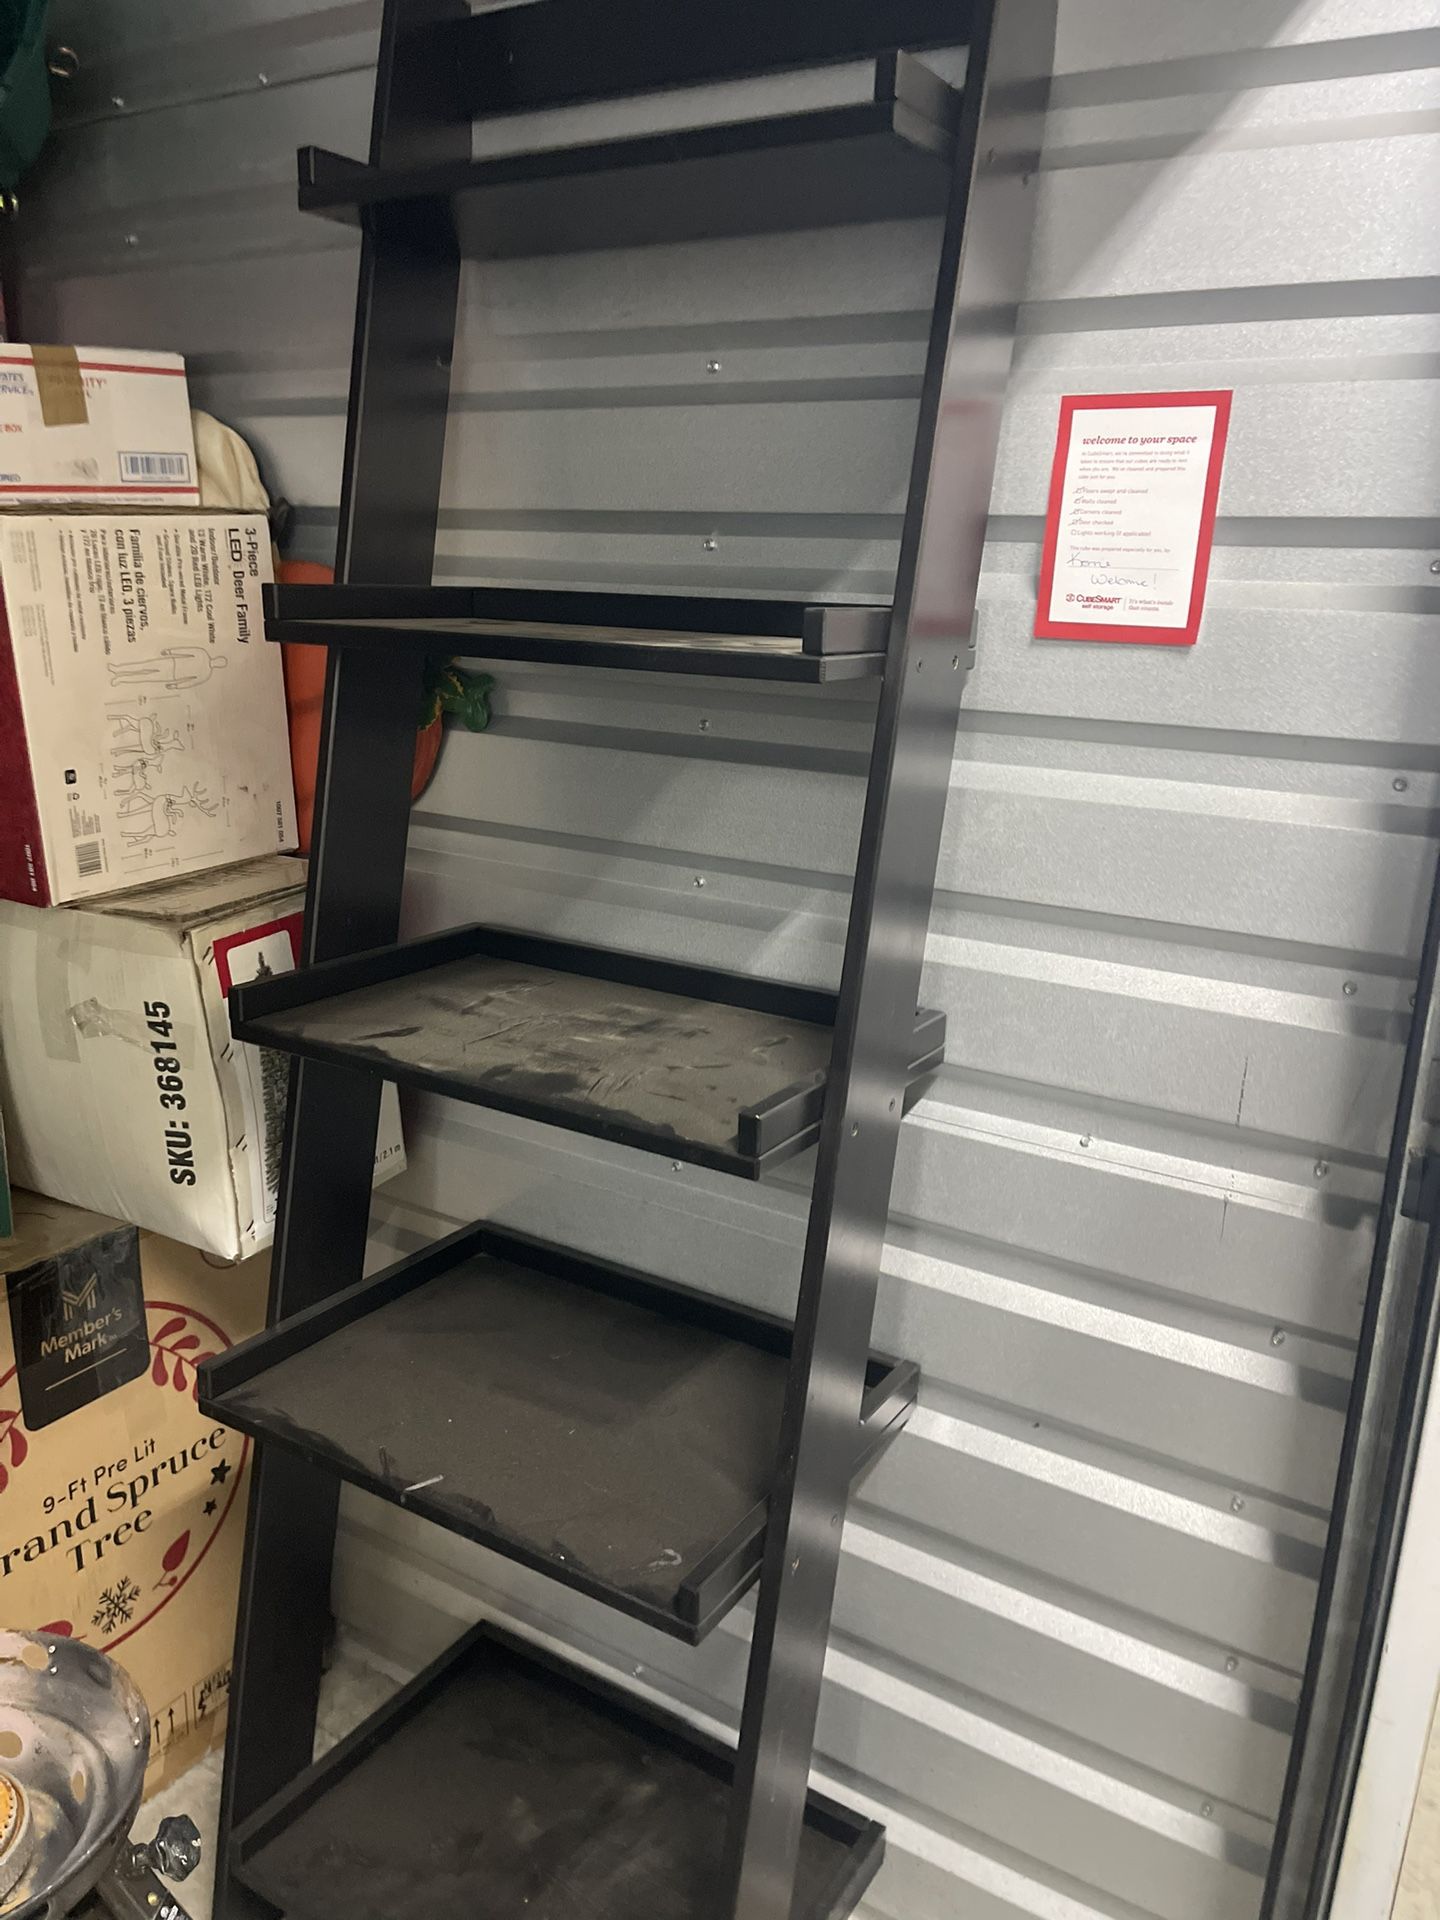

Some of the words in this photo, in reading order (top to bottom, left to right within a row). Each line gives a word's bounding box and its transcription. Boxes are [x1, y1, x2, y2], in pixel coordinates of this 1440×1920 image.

[0, 372, 24, 382] ATES
[0, 384, 27, 394] RVICE
[1082, 435, 1126, 445] welcome
[1128, 436, 1138, 445] to
[1140, 436, 1166, 446] your
[1167, 436, 1197, 446] space
[115, 530, 126, 550] con
[130, 529, 144, 569] Familia
[228, 528, 242, 562] LED
[245, 528, 259, 577] 3-Piece
[118, 553, 129, 570] luz
[135, 570, 145, 585] de
[120, 572, 133, 596] LED,
[193, 573, 201, 589] LED
[233, 571, 245, 601] Deer
[124, 598, 134, 607] 3
[136, 588, 149, 631] ciervos,
[123, 608, 137, 643] piezas
[236, 604, 249, 644] Family
[144, 1000, 187, 1111] 368145
[165, 1120, 196, 1186] SKU:
[40, 1307, 122, 1356] Member's
[65, 1332, 108, 1363] Mark
[42, 1477, 88, 1514] 9-Ft
[94, 1458, 128, 1486] Pre
[134, 1438, 156, 1463] Lit
[0, 1496, 99, 1577] rand
[106, 1427, 227, 1513] Spruce
[66, 1509, 153, 1573] Tree
